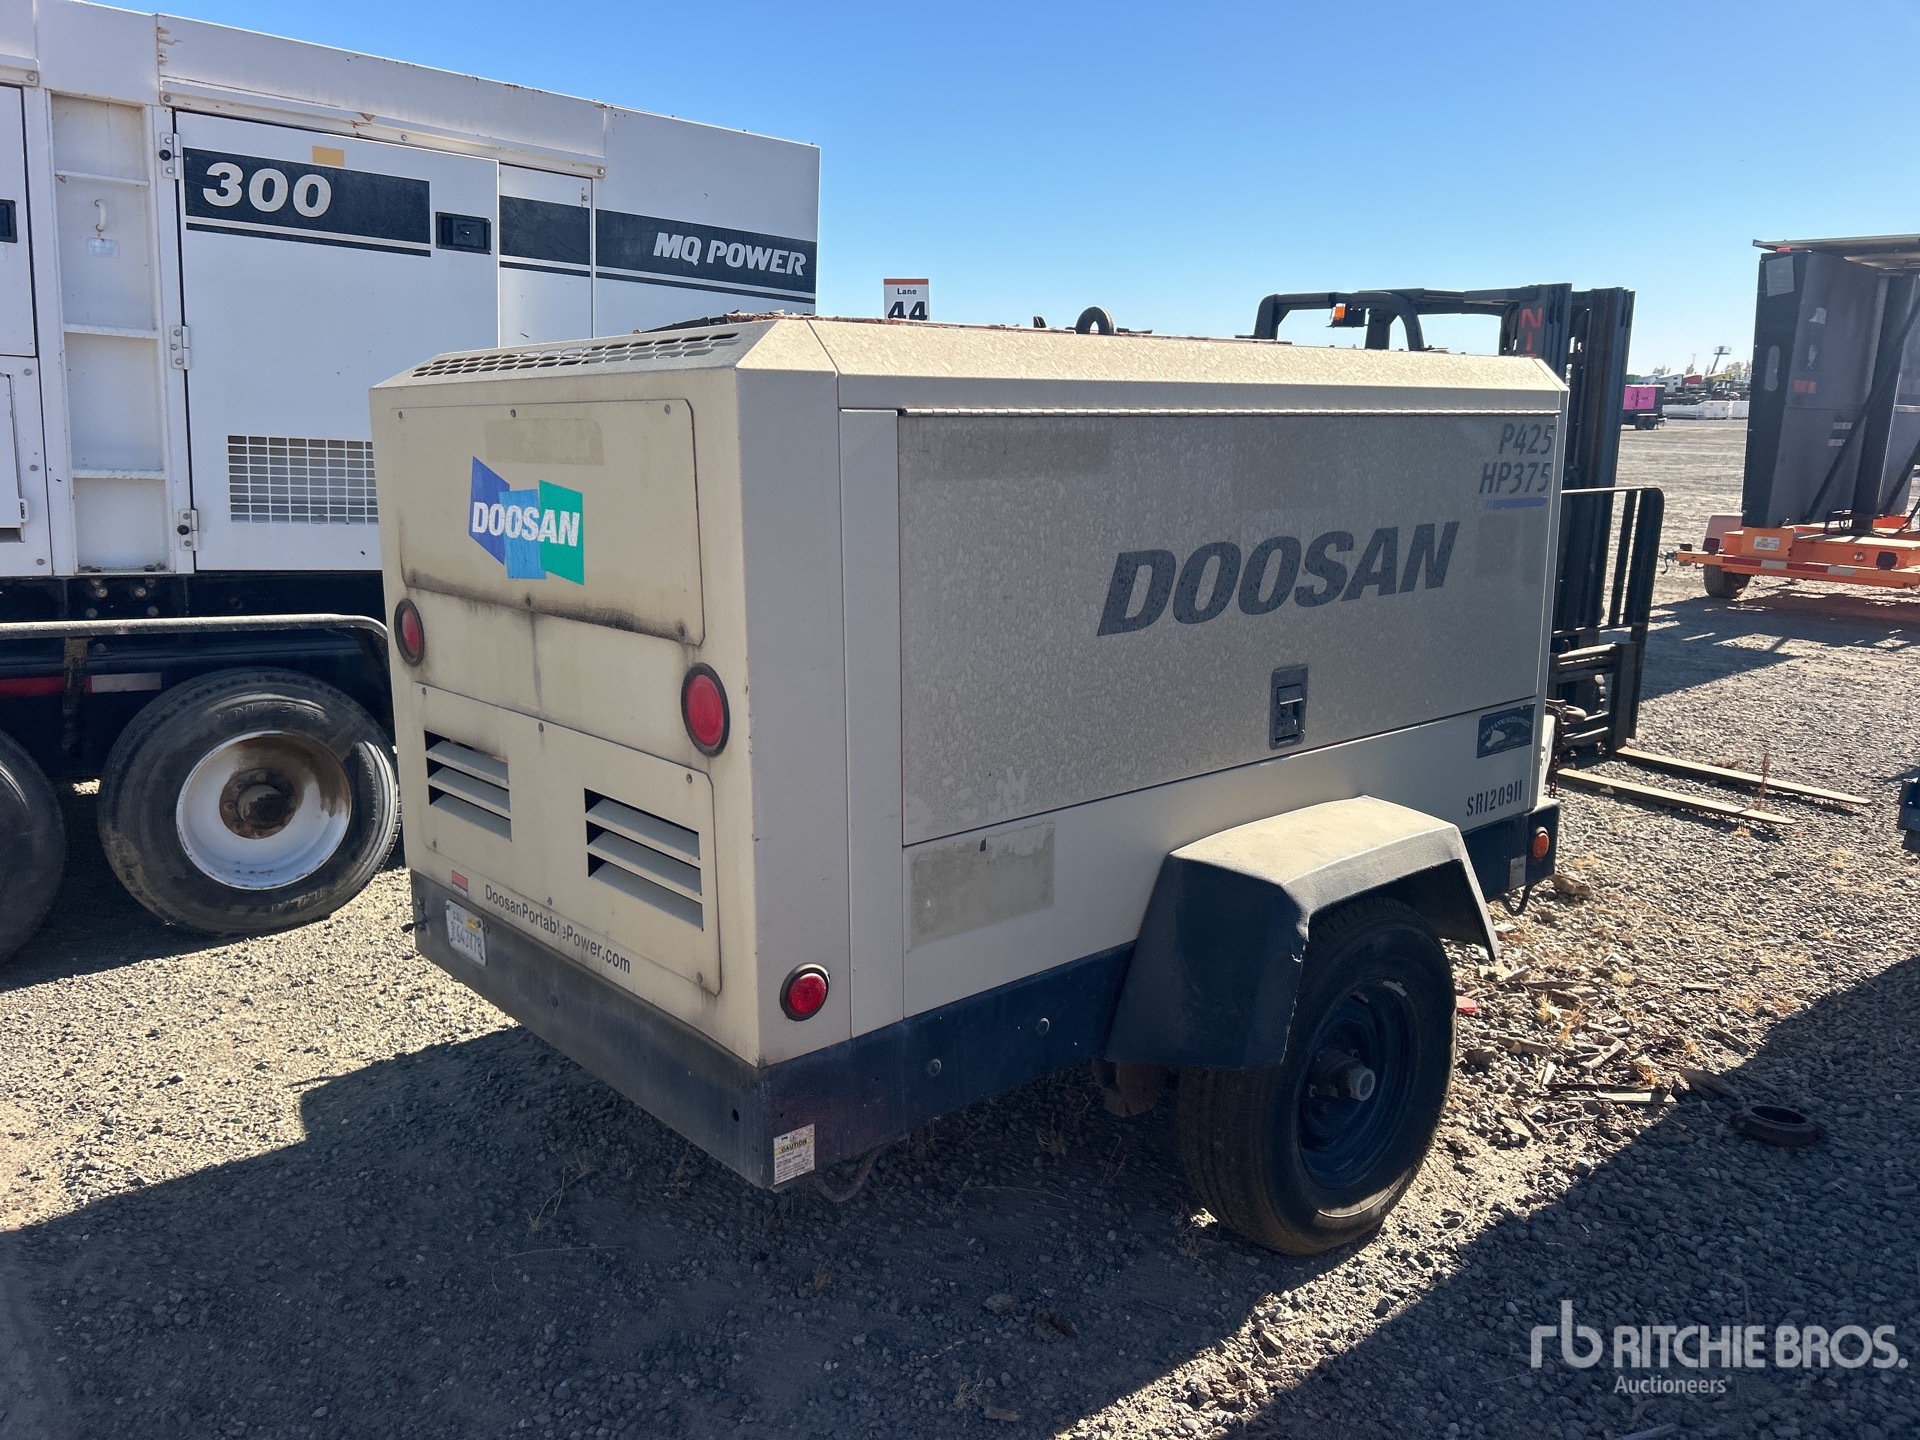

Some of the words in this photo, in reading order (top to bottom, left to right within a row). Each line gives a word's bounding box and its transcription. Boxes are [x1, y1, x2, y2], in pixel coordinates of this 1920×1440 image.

[202, 162, 332, 218] 300
[652, 231, 702, 266] MQ
[706, 239, 807, 276] POWER
[887, 301, 928, 321] 44
[1520, 307, 1544, 358] NI
[1498, 423, 1555, 455] P425
[1478, 461, 1552, 495] HP375
[472, 501, 580, 547] DOOSAN
[1096, 520, 1460, 637] DOOSAN
[781, 1138, 807, 1153] CAUTION
